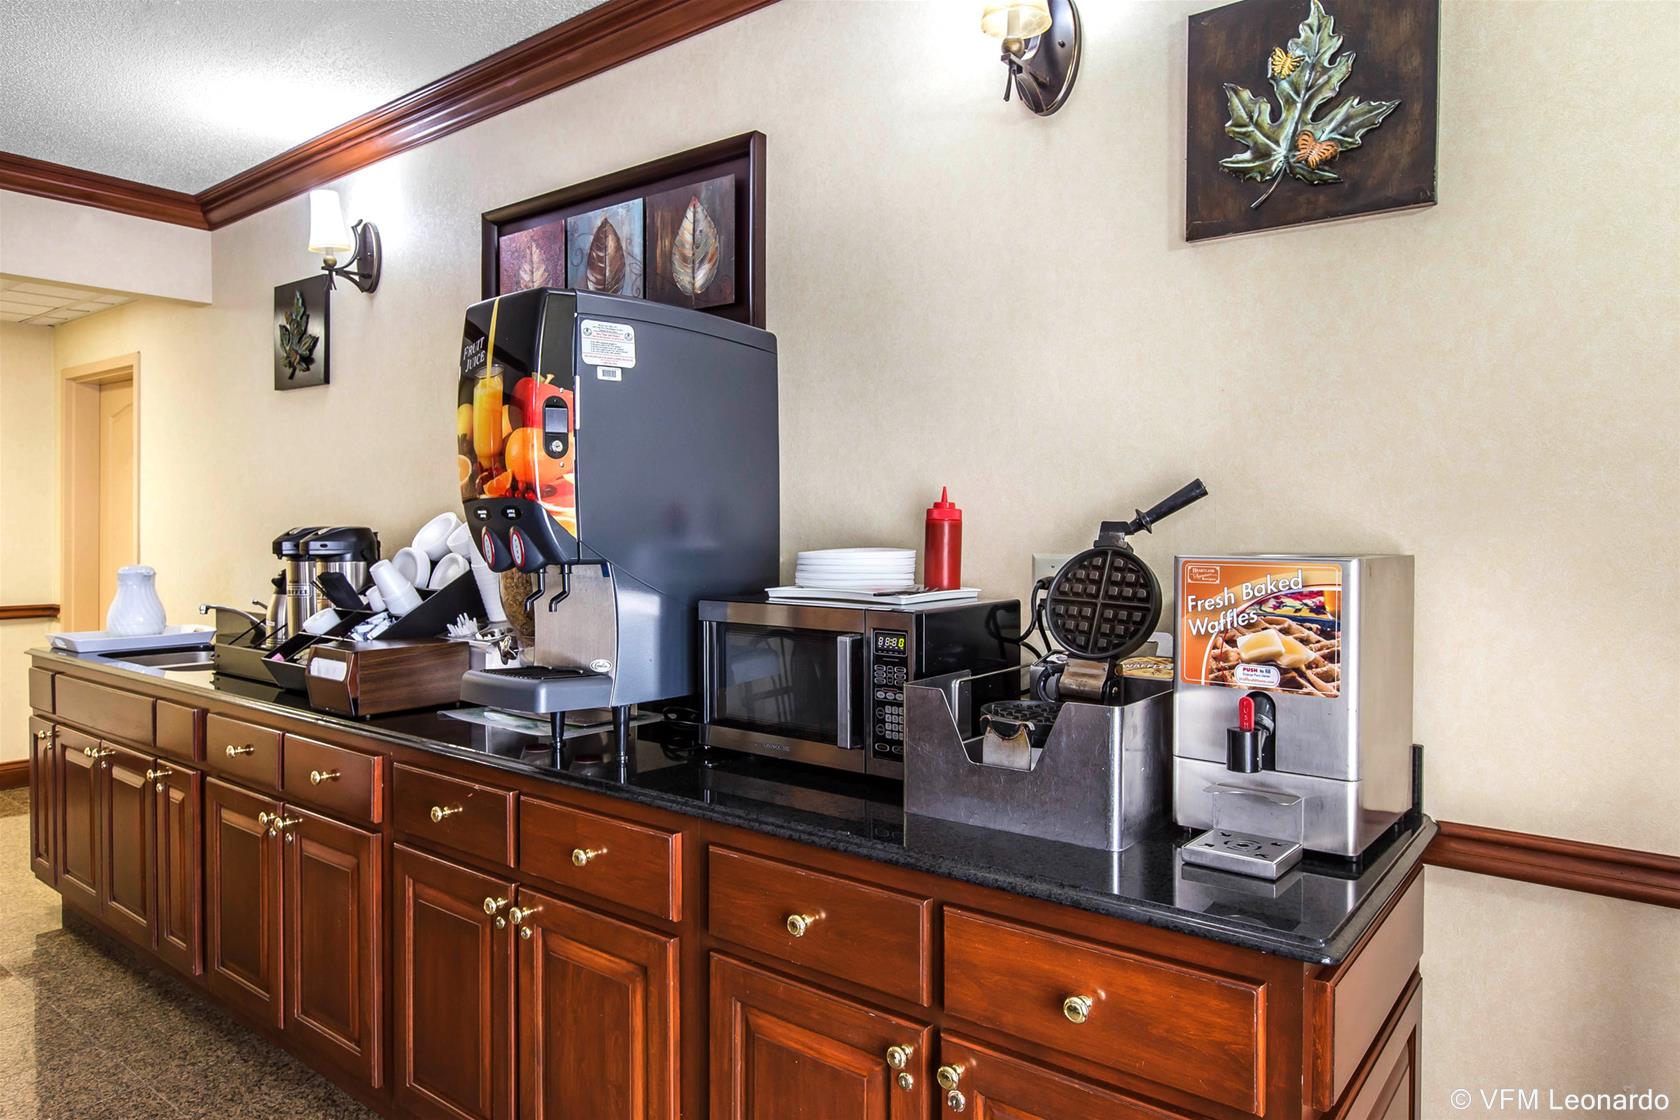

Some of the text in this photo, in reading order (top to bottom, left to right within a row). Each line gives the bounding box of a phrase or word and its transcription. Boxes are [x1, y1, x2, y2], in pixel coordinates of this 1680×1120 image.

[463, 336, 485, 360] FRUIT
[465, 350, 486, 373] JUICE
[1187, 569, 1303, 612] Fresh Baked
[1188, 608, 1258, 636] Waffles
